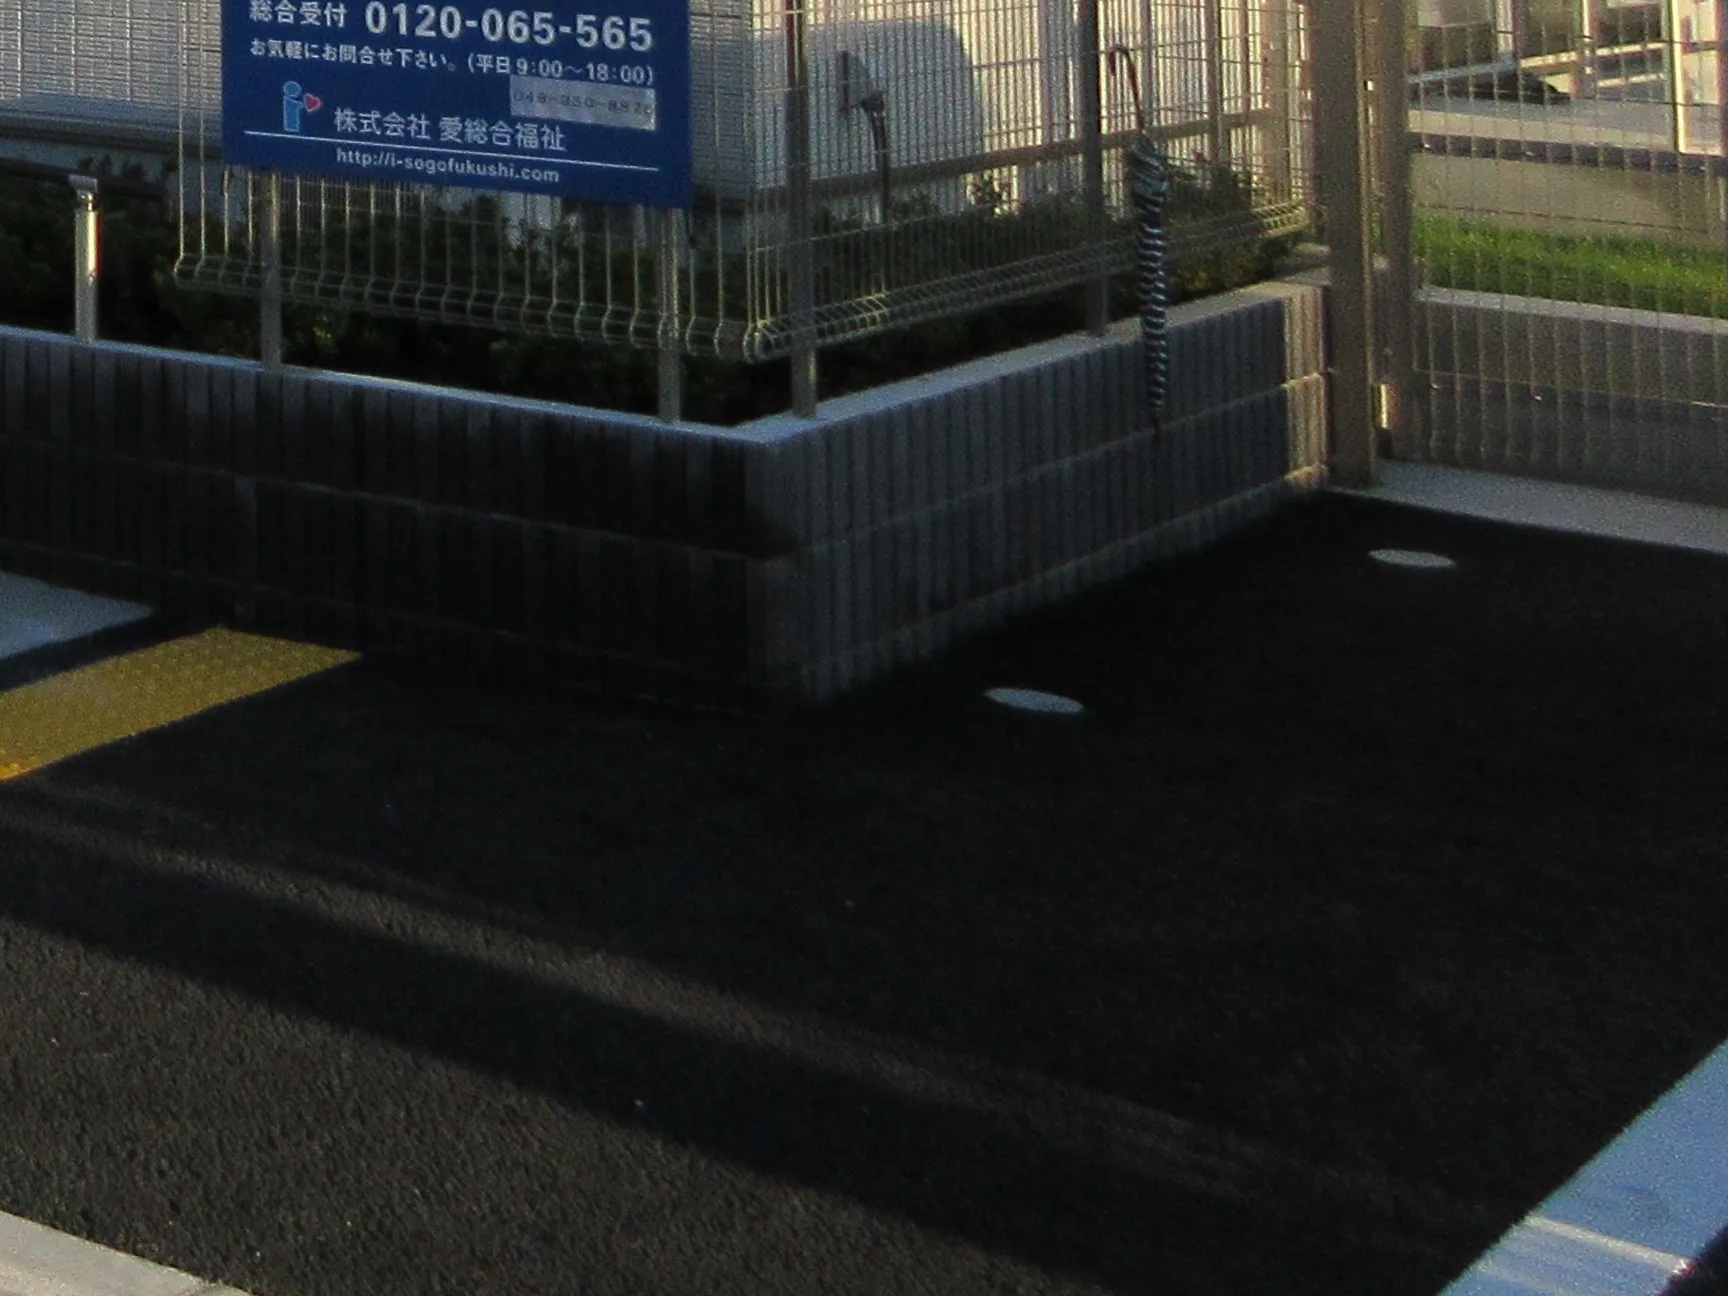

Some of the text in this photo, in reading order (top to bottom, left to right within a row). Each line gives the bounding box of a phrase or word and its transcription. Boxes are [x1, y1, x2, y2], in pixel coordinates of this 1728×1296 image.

[365, 0, 653, 52] 0120-065-565
[334, 106, 567, 150] 株式会社 愛総合福祉
[336, 148, 560, 183] http://i-sogofukushi.com
